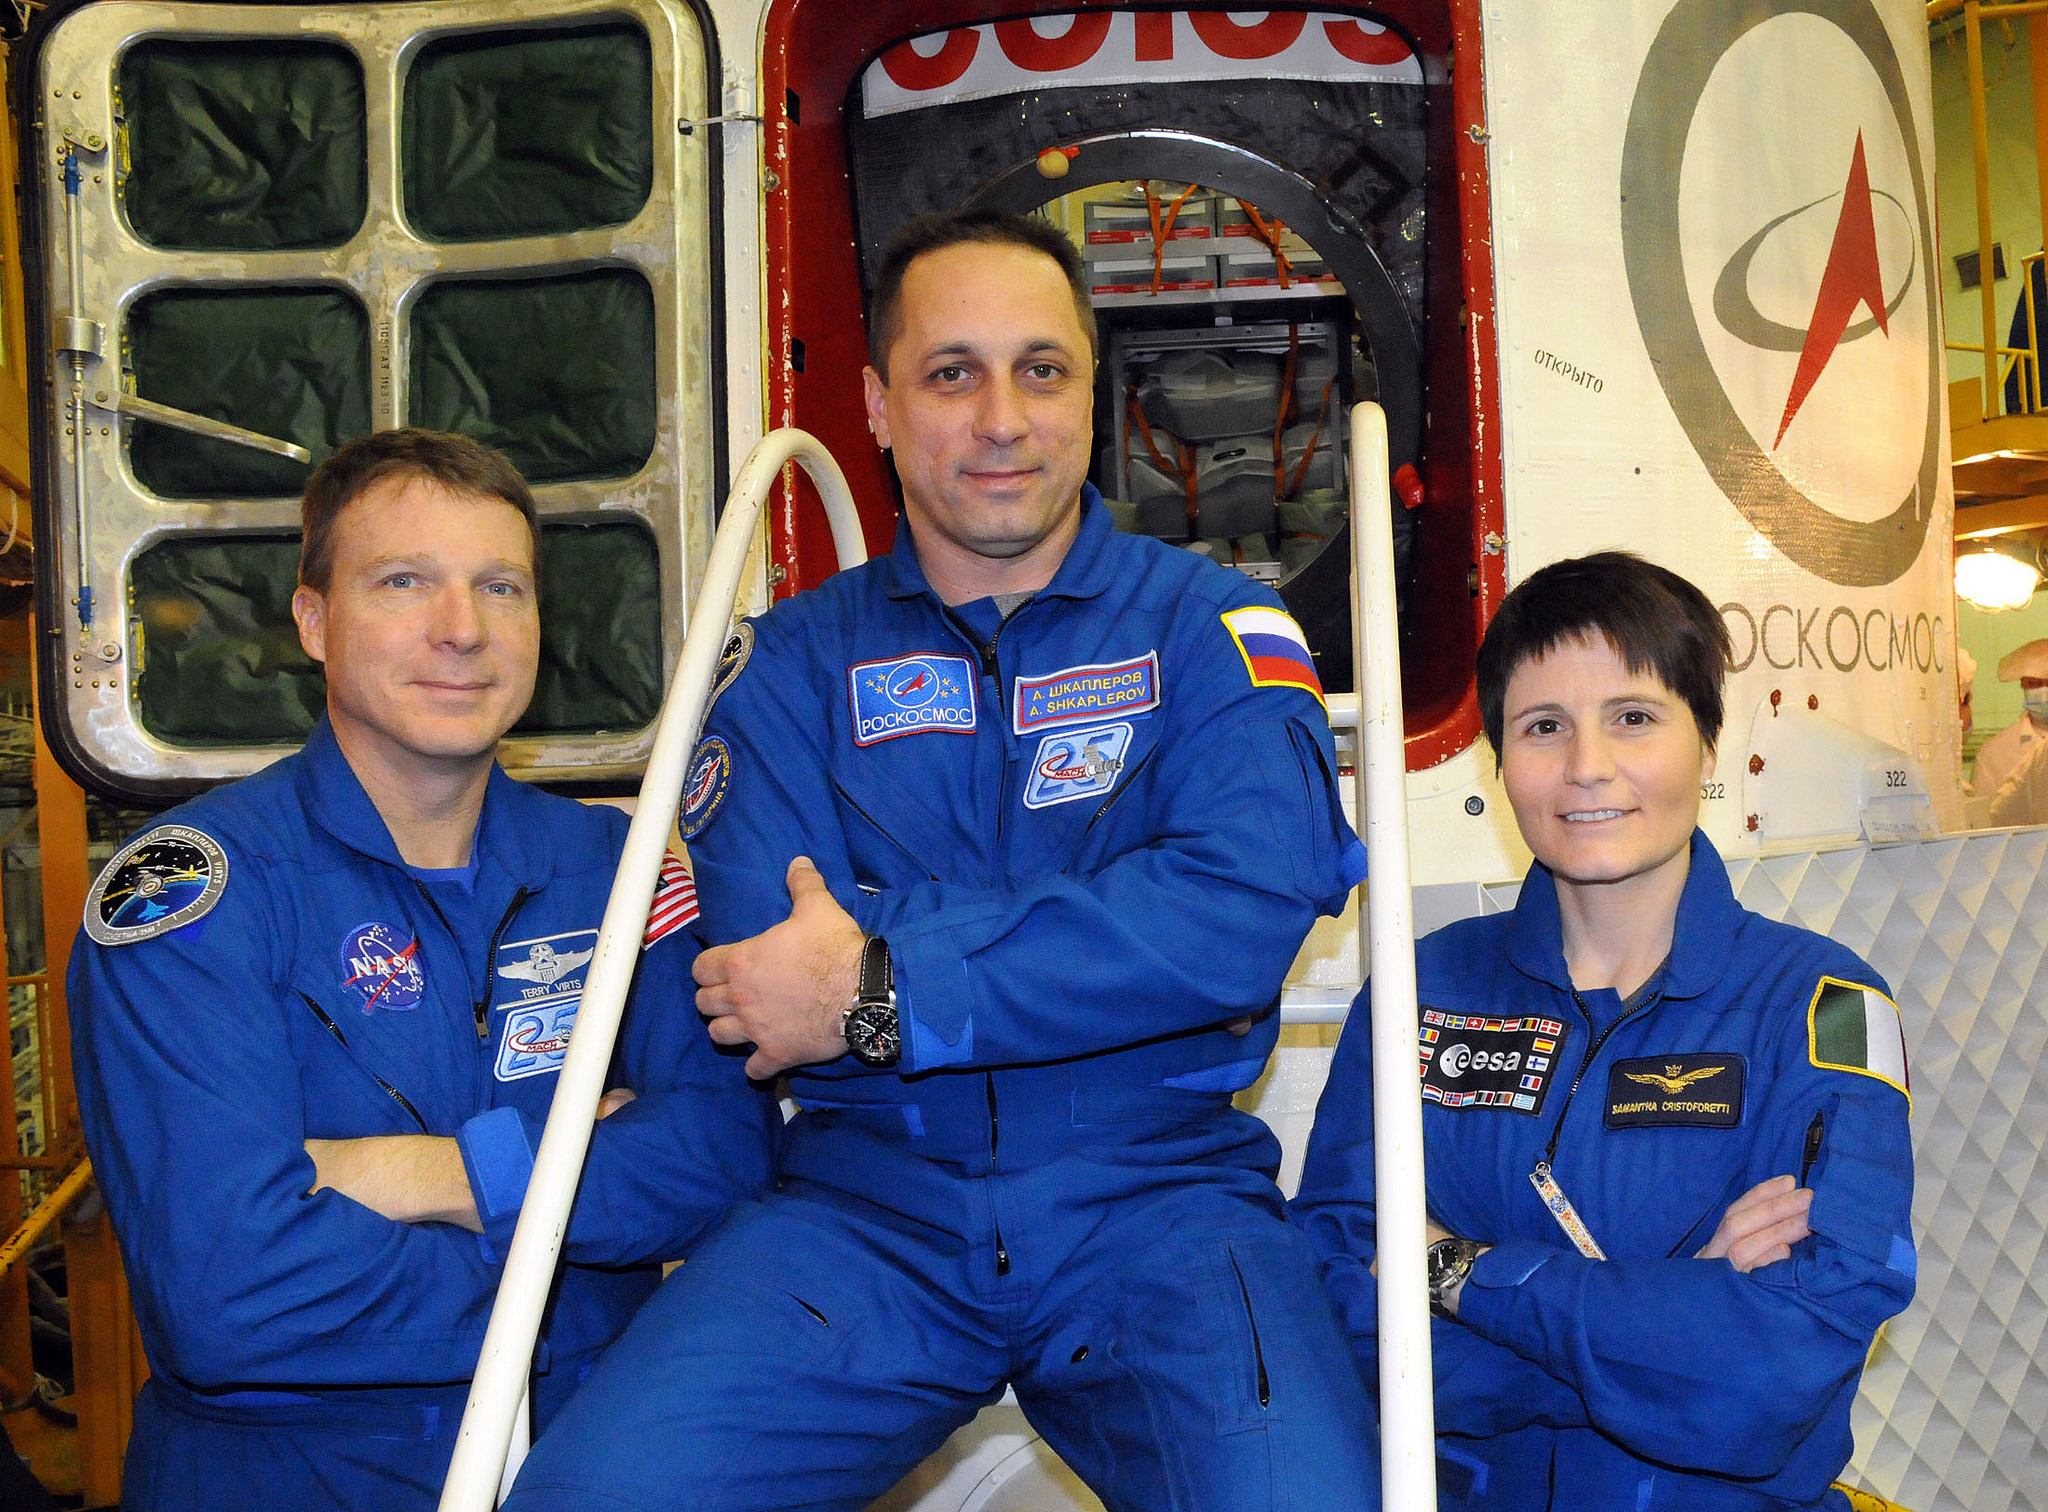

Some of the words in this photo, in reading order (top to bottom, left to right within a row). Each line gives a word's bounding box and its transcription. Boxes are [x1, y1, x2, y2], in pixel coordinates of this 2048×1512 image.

[1534, 349, 1604, 394] ОТКРЫТО
[1717, 602, 1944, 674] ОСКОСМОС
[1032, 690, 1045, 702] А.
[1049, 671, 1143, 699] ШКАПЛЕРОВ
[1029, 705, 1042, 718] A.
[1046, 685, 1147, 714] SHKAPLEROV
[861, 707, 972, 736] РОСКОСМОС
[1886, 771, 1907, 787] 322
[213, 861, 222, 885] VIRTS
[349, 955, 421, 979] NASA
[521, 985, 551, 999] TERRY
[555, 979, 582, 992] VIRTS
[526, 1042, 558, 1053] MACH
[1471, 1050, 1522, 1072] esa
[1611, 1101, 1658, 1115] SAMANTHA
[1661, 1101, 1730, 1115] CRISTOFORETTI
